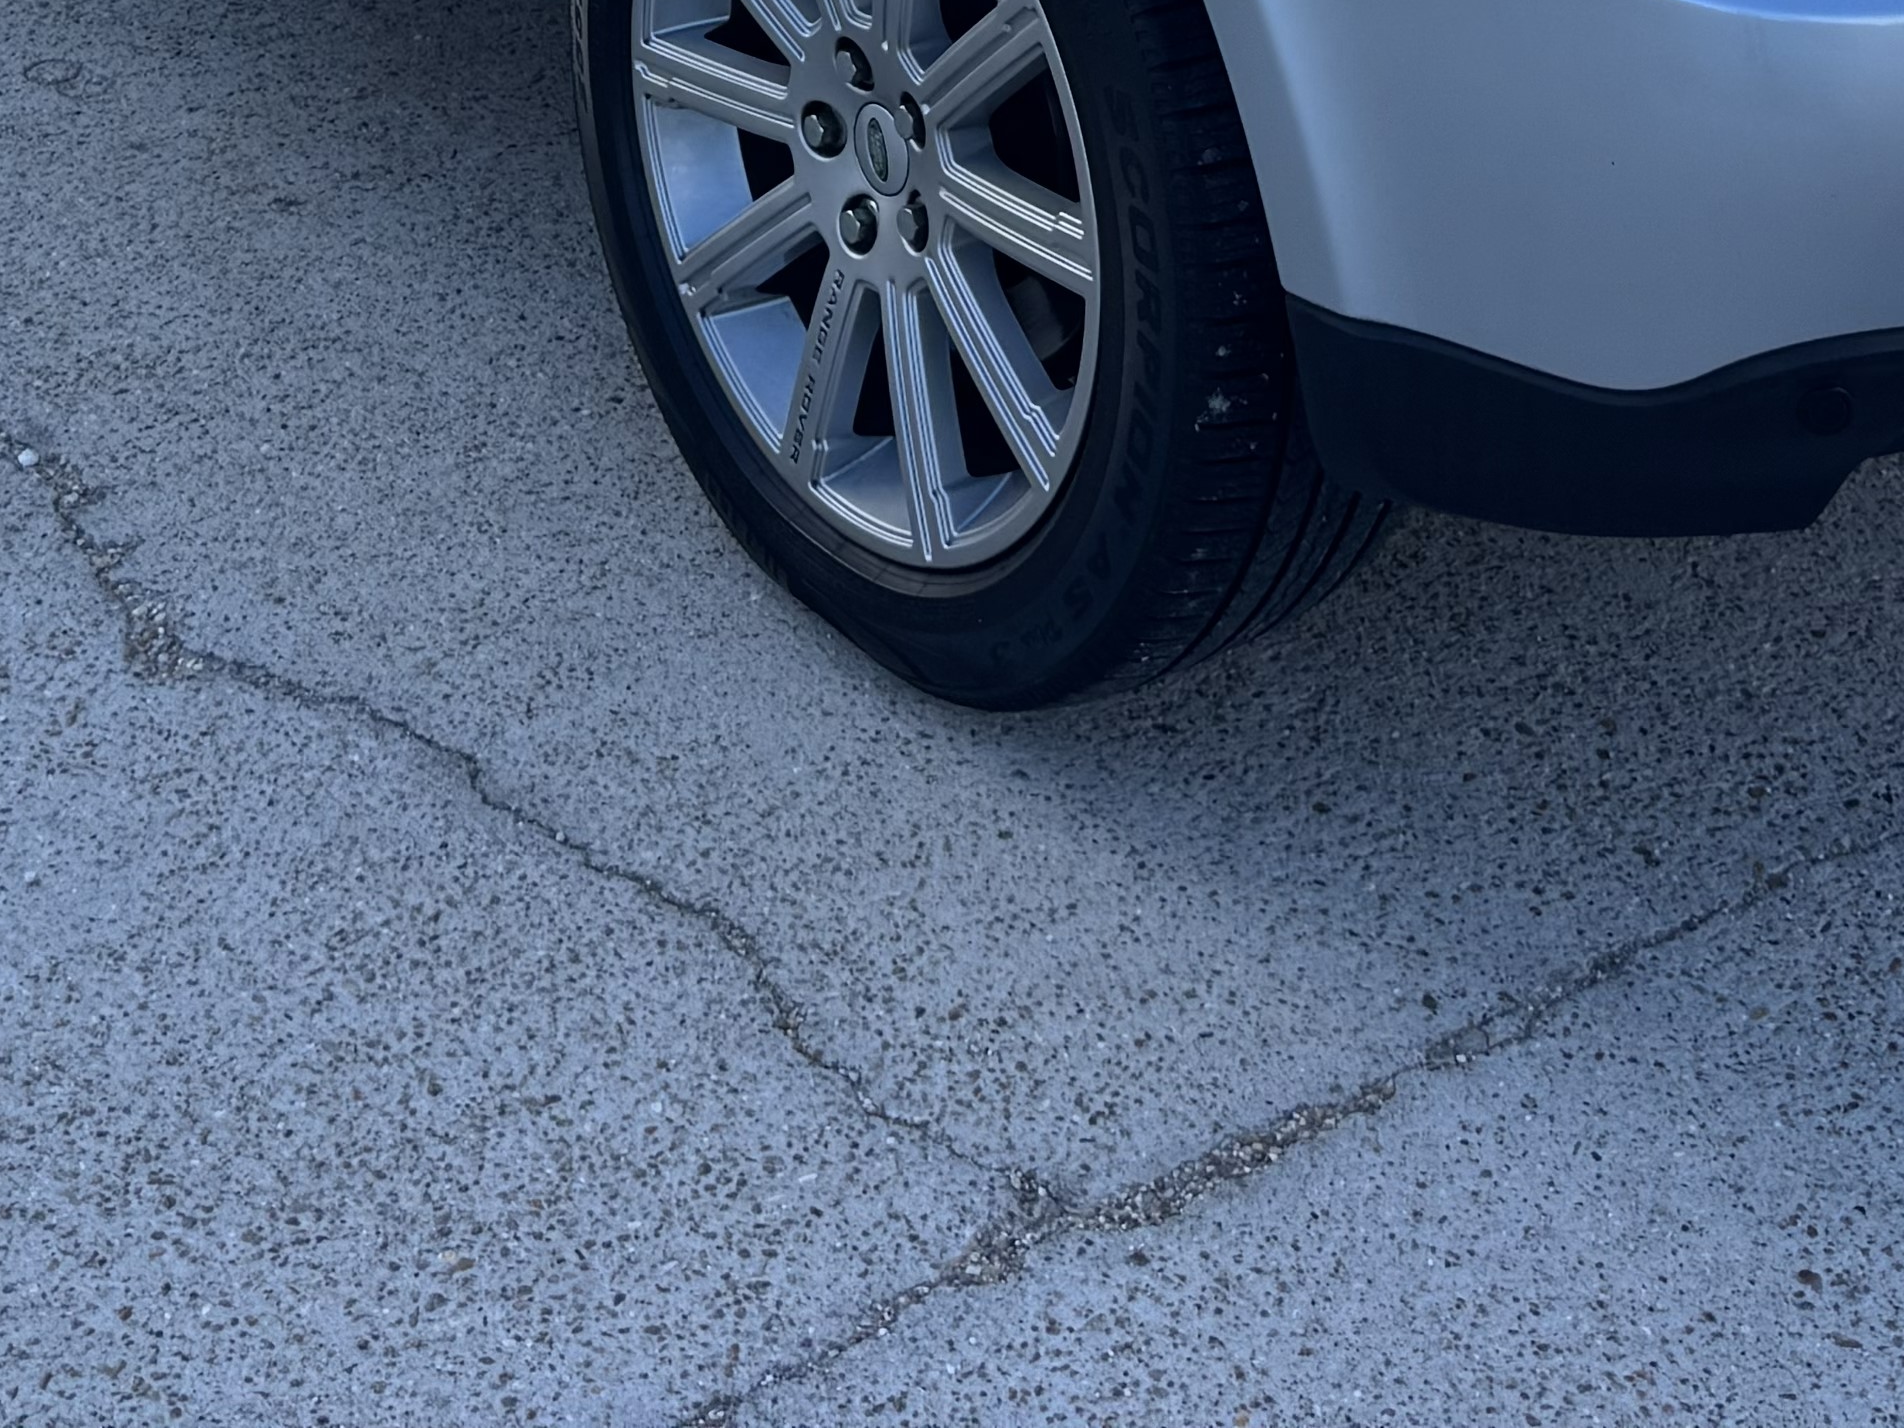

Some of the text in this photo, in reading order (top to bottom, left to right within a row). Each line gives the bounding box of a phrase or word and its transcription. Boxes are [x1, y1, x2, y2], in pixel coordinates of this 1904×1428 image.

[790, 268, 845, 464] RANGE ROVER
[1102, 82, 1162, 526] SCORPION
